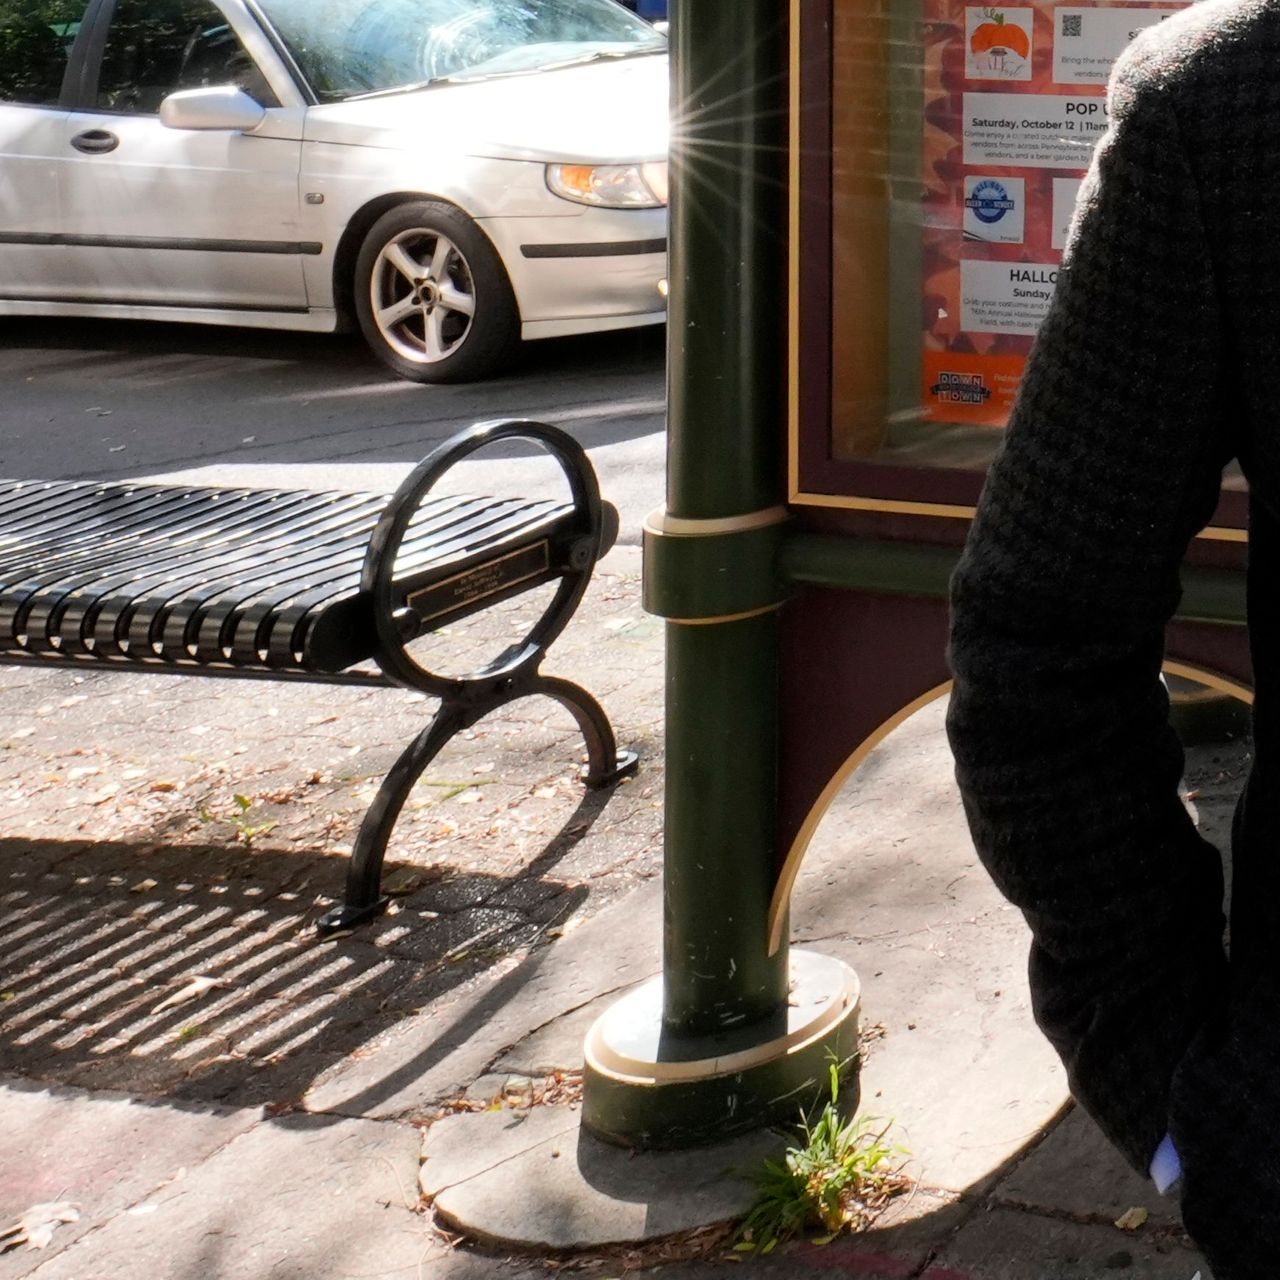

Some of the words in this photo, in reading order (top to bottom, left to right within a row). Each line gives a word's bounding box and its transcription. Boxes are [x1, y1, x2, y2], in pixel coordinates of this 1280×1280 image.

[1066, 103, 1098, 115] POP
[972, 118, 1019, 130] Saturday,
[1021, 119, 1062, 130] October
[1065, 121, 1075, 130] 12
[1010, 269, 1058, 283] HALLO
[1013, 288, 1053, 300] Sunday,
[941, 374, 981, 385] DOWN
[942, 391, 981, 402] TOWN
